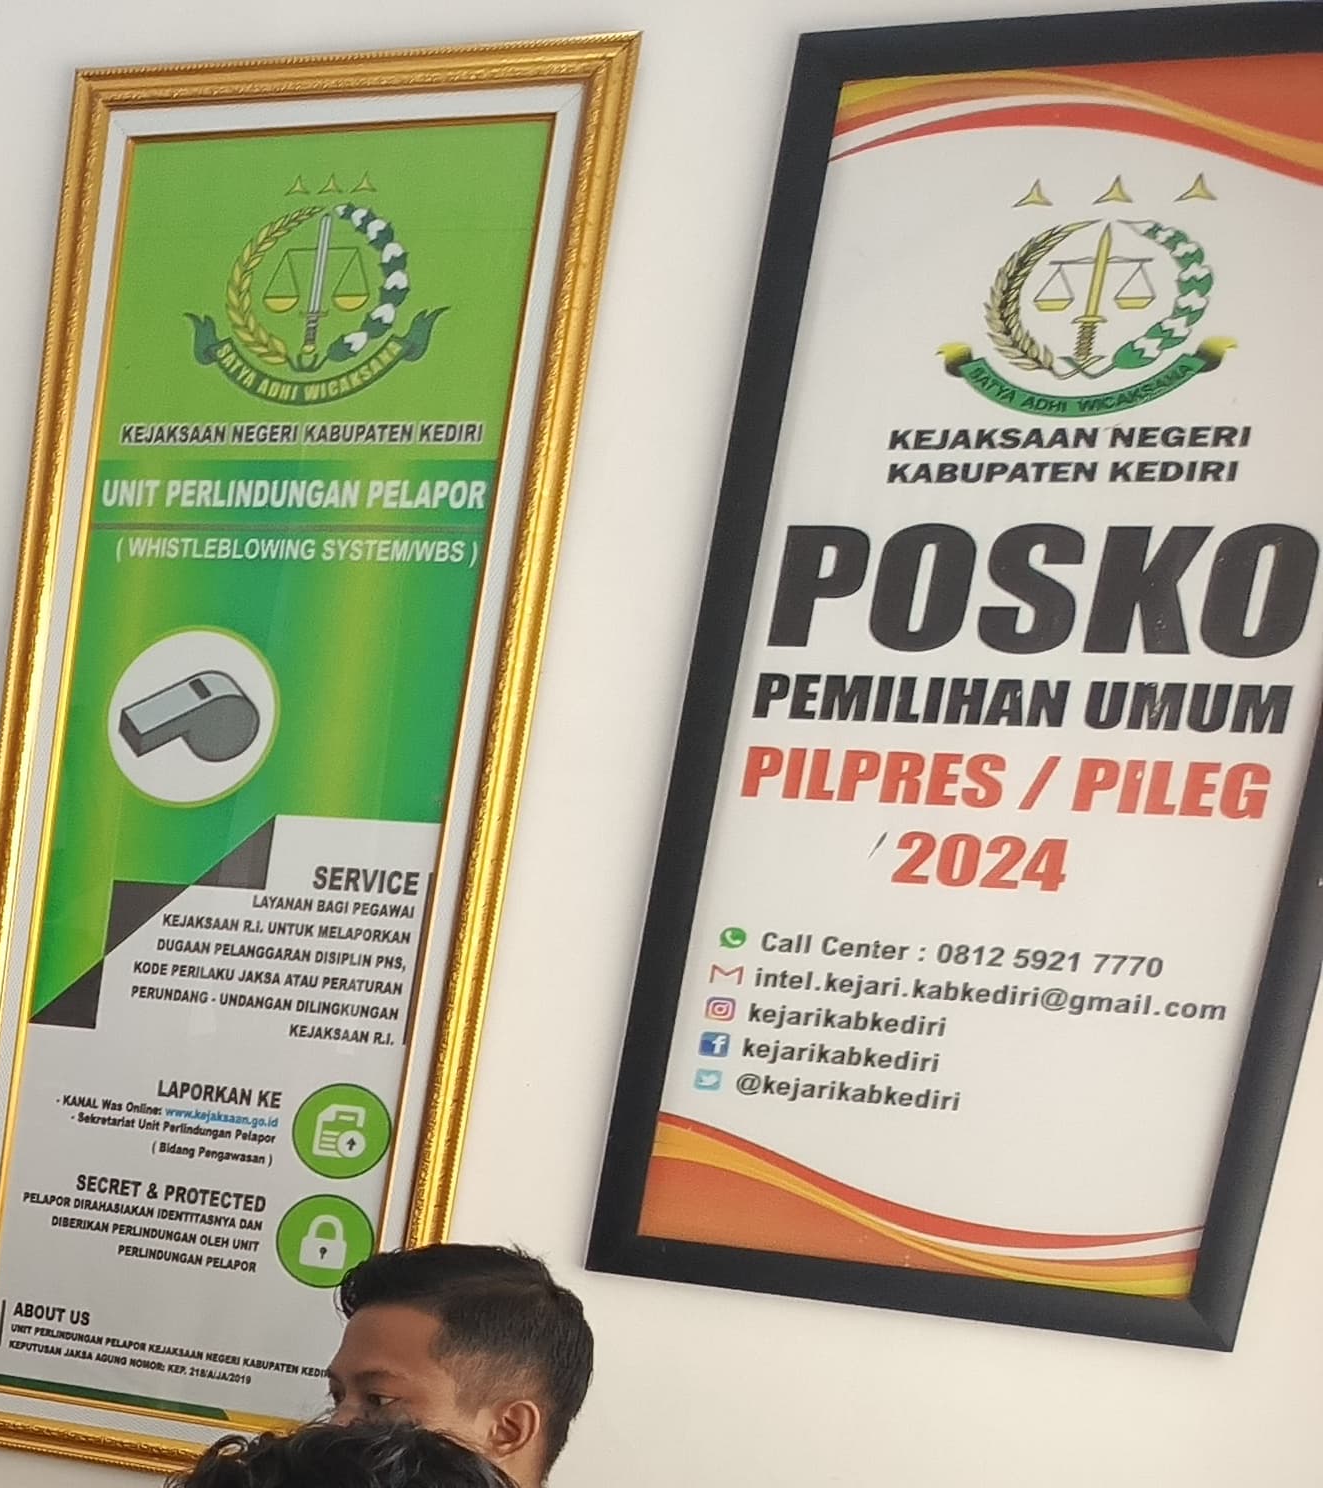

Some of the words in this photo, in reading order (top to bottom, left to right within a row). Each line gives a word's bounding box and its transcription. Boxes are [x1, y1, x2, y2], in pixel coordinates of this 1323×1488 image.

[217, 342, 257, 388] SATYA
[257, 378, 299, 400] ADHI
[304, 340, 403, 400] WICAKSANA
[121, 425, 226, 443] KEJAKSAAN
[231, 424, 298, 443] NEGERI
[303, 424, 413, 443] KABUPATEN
[418, 423, 483, 442] KEDIRI
[888, 427, 1098, 450] KEJAKSAAN
[1110, 426, 1251, 448] NEGERI
[886, 461, 1098, 483] KABUPATEN
[1109, 460, 1238, 482] KEDIRI
[102, 479, 160, 507] UNIT
[165, 479, 360, 508] PERLINDUNGAN
[366, 480, 487, 509] PELAPOR
[128, 537, 316, 560] WHISTLEBLOWING
[321, 539, 466, 562] SYSTEM/WBS
[767, 522, 1320, 659] POSKO
[752, 672, 1071, 728] PEMILIHAN
[1084, 680, 1294, 735] UMUM
[741, 746, 1007, 809] PILPRES
[1018, 755, 1061, 810] /
[1071, 758, 1272, 820] PILEG
[891, 831, 1069, 892] 2024
[312, 865, 420, 896] SERVICE
[252, 894, 313, 911] LAYANAN
[316, 899, 349, 914] BAGI
[352, 901, 415, 919] PEGAWAI
[162, 913, 239, 931] KEJAKSAAN
[242, 919, 263, 933] R.I.
[267, 921, 314, 937] UNTUK
[317, 925, 411, 944] MELAPORKAN
[156, 938, 211, 954] DUGAAN
[213, 942, 311, 962] PELANGGARAN
[314, 950, 372, 967] DISIPLIN
[375, 955, 406, 972] PNS,
[761, 931, 812, 954] Call
[821, 935, 910, 961] Center
[936, 943, 1005, 967] 0812
[1012, 948, 1080, 972] 5921
[1093, 953, 1163, 978] 7770
[133, 960, 168, 976] KODE
[170, 963, 235, 981] PERILAKU
[237, 969, 280, 985] JAKSA
[283, 973, 319, 988] ATAU
[321, 976, 403, 995] PERATURAN
[755, 967, 1228, 1022] intel.kejari.kabkediri@gmail.com
[130, 985, 208, 1004] PERUNDANG
[219, 993, 292, 1011] UNDANGAN
[295, 999, 399, 1020] DILINGKUNGAN
[289, 1023, 369, 1043] KEJAKSAAN
[373, 1031, 394, 1046] R.I.
[747, 1003, 947, 1038] kejarikabkediri
[741, 1038, 940, 1074] kejarikabkediri
[157, 1079, 252, 1106] LAPORKAN
[257, 1090, 282, 1109] KE
[735, 1072, 961, 1112] @kejarikabkediri
[62, 1094, 99, 1109] KANAL
[101, 1098, 123, 1112] Was
[125, 1101, 162, 1116] Online:
[165, 1108, 278, 1128] www.kejaksaan.go.id
[77, 1111, 135, 1128] Sekretariat
[138, 1118, 160, 1131] Unit
[162, 1120, 232, 1140] Perlindungan
[234, 1128, 276, 1145] Pelapor
[158, 1141, 196, 1159] Bidang
[197, 1146, 265, 1164] Pengawasan
[76, 1174, 142, 1197] SECRET
[146, 1182, 158, 1199] &
[163, 1184, 266, 1212] PROTECTED
[22, 1191, 71, 1207] PELAPOR
[73, 1198, 154, 1218] DIRAHASIAKAN
[156, 1208, 236, 1228] IDENTITASNYA
[239, 1218, 263, 1231] DAN
[51, 1215, 109, 1233] DIBERIKAN
[111, 1222, 197, 1244] PERLINDUNGAN
[199, 1234, 229, 1248] OLEH
[232, 1238, 259, 1252] UNIT
[117, 1244, 203, 1265] PERLINDUNGAN
[205, 1255, 256, 1273] PELAPOR
[12, 1301, 66, 1322] ABOUT
[69, 1309, 90, 1326] US
[8, 1339, 62, 1356] KEPUTUSAN
[63, 1348, 93, 1360] JAKSA
[94, 1352, 127, 1365] AGUNG
[129, 1358, 165, 1371] NOMOR:
[167, 1364, 186, 1375] KEP.
[10, 1323, 33, 1334] UNIT
[33, 1326, 103, 1345] PERLINDUNGAN
[105, 1337, 146, 1351] PELAPOR
[147, 1343, 203, 1360] KEJAKSAAN
[205, 1352, 240, 1365] NEGERI
[242, 1358, 299, 1374] KABUPATEN
